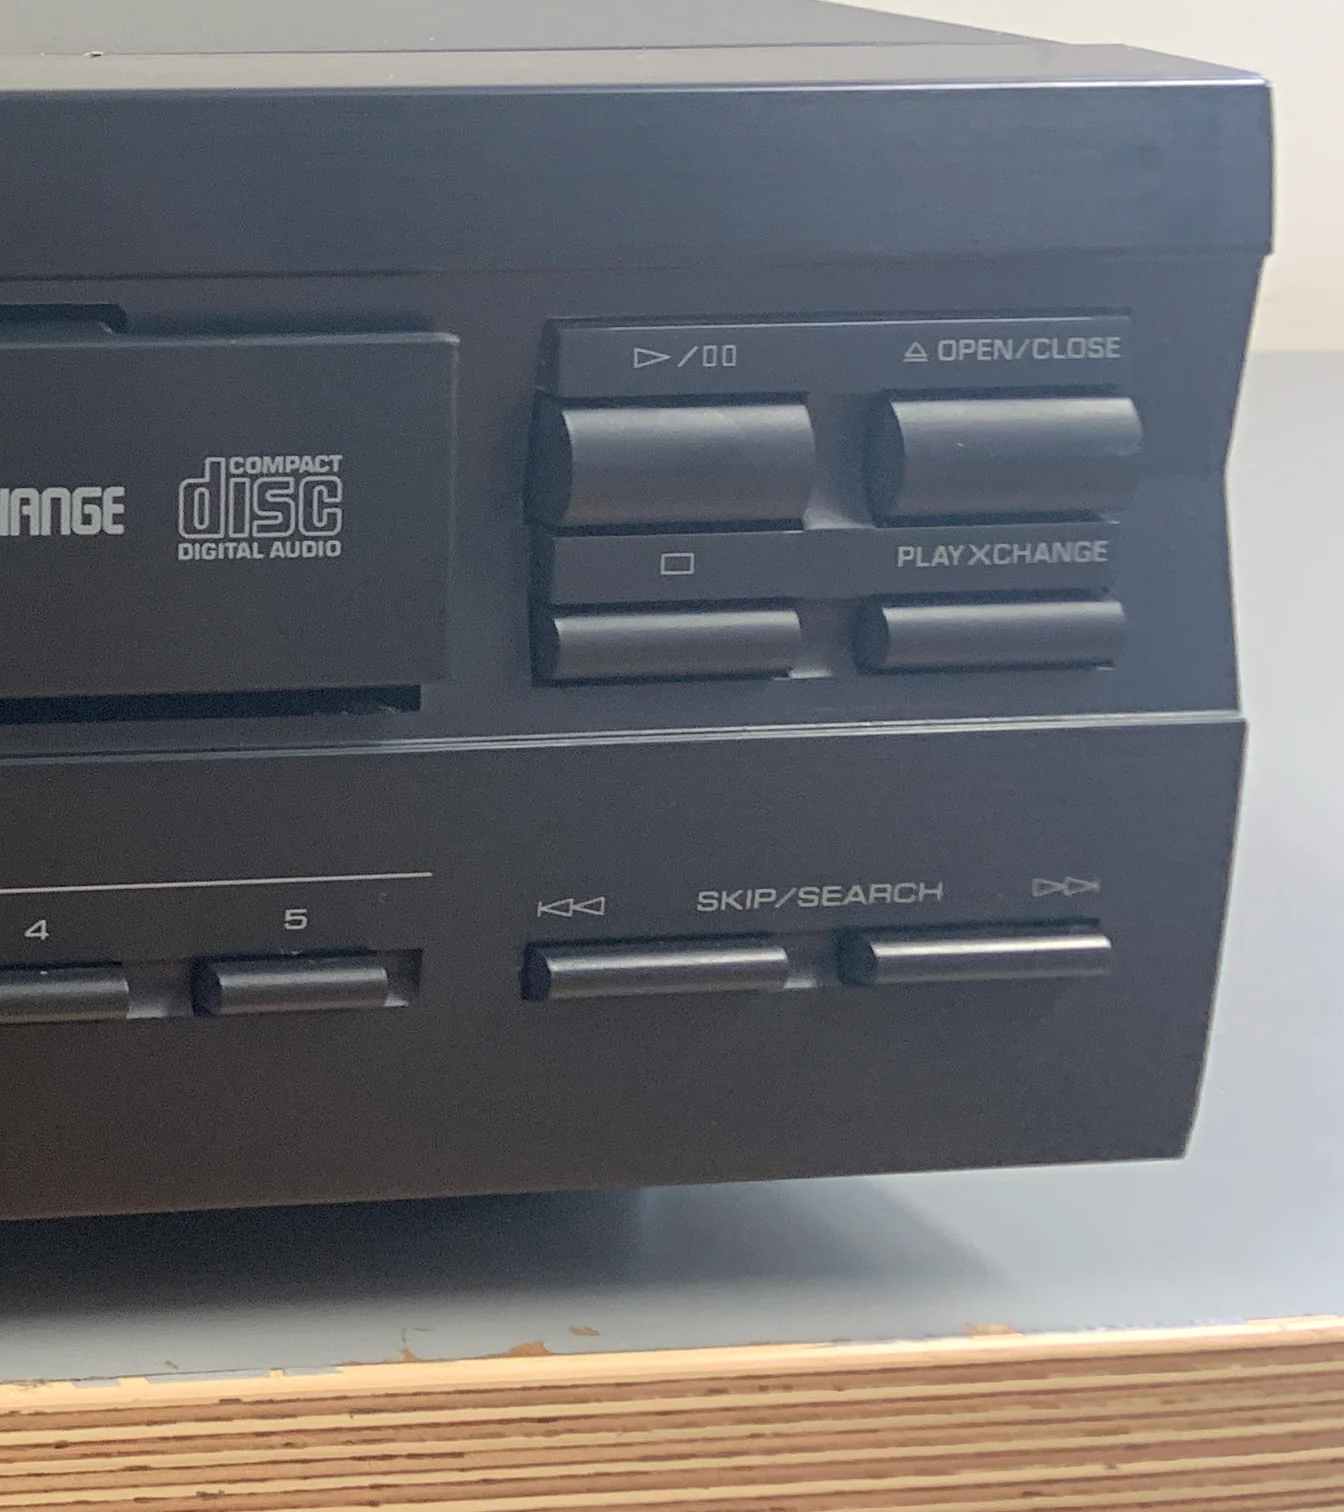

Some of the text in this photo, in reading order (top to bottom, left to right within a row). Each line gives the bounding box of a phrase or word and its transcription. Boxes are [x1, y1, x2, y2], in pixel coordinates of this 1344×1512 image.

[937, 337, 1122, 362] OPEN/CLOSE
[228, 455, 343, 475] COMPACT
[177, 540, 342, 560] DIGITAL AUDIO
[696, 882, 944, 912] SKIP/SEARCH
[24, 919, 50, 942] 4
[284, 908, 308, 930] 5
